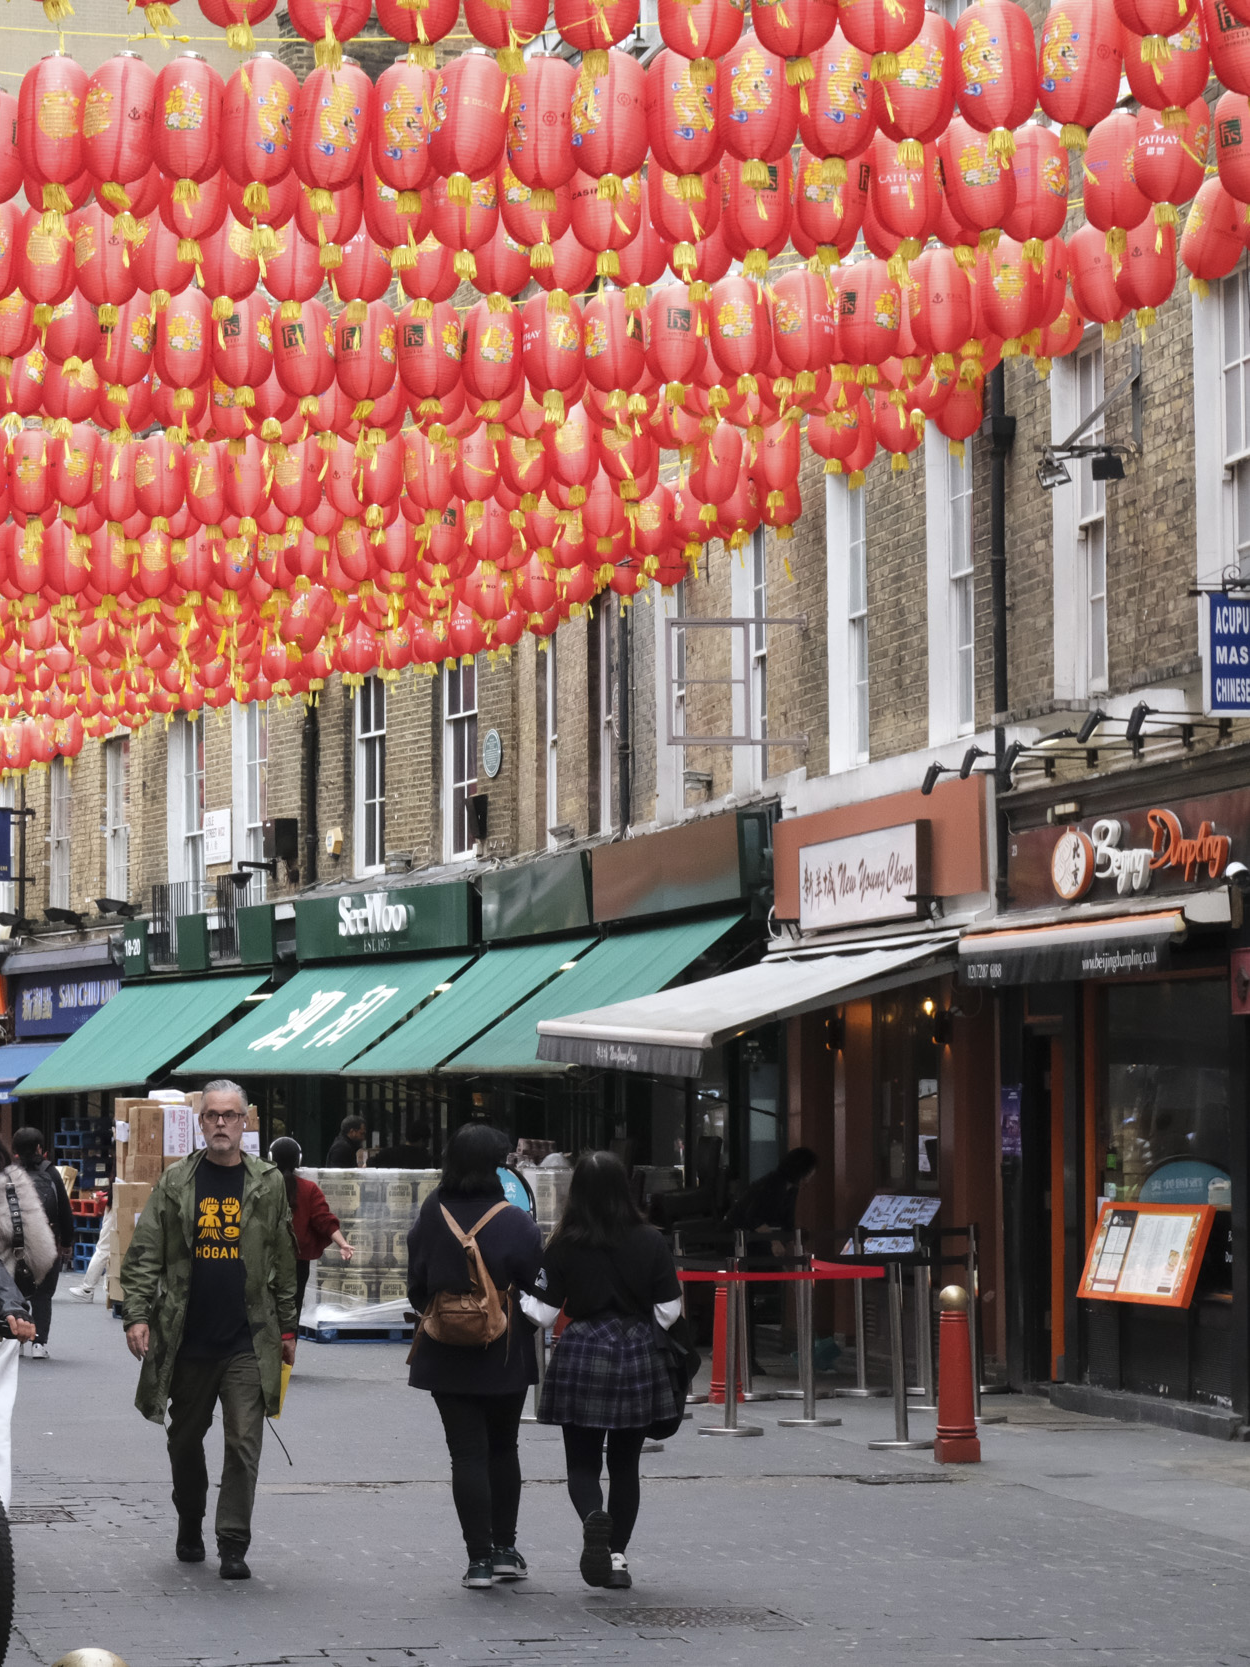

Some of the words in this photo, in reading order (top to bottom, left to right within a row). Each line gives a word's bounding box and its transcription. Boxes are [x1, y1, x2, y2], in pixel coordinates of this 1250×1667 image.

[1138, 134, 1179, 147] CATHAY
[523, 329, 541, 342] THAY
[1216, 677, 1250, 703] CHINESE
[1011, 844, 1018, 857] 23
[1091, 818, 1154, 895] Beijing
[1147, 808, 1231, 882] Dumpling
[837, 862, 857, 898] New
[858, 857, 885, 903] Young
[886, 851, 914, 895] Cheng
[124, 938, 141, 957] 18-20
[58, 983, 78, 1009] SAN
[78, 980, 101, 1008] CHIU
[505, 1181, 517, 1193] 卖
